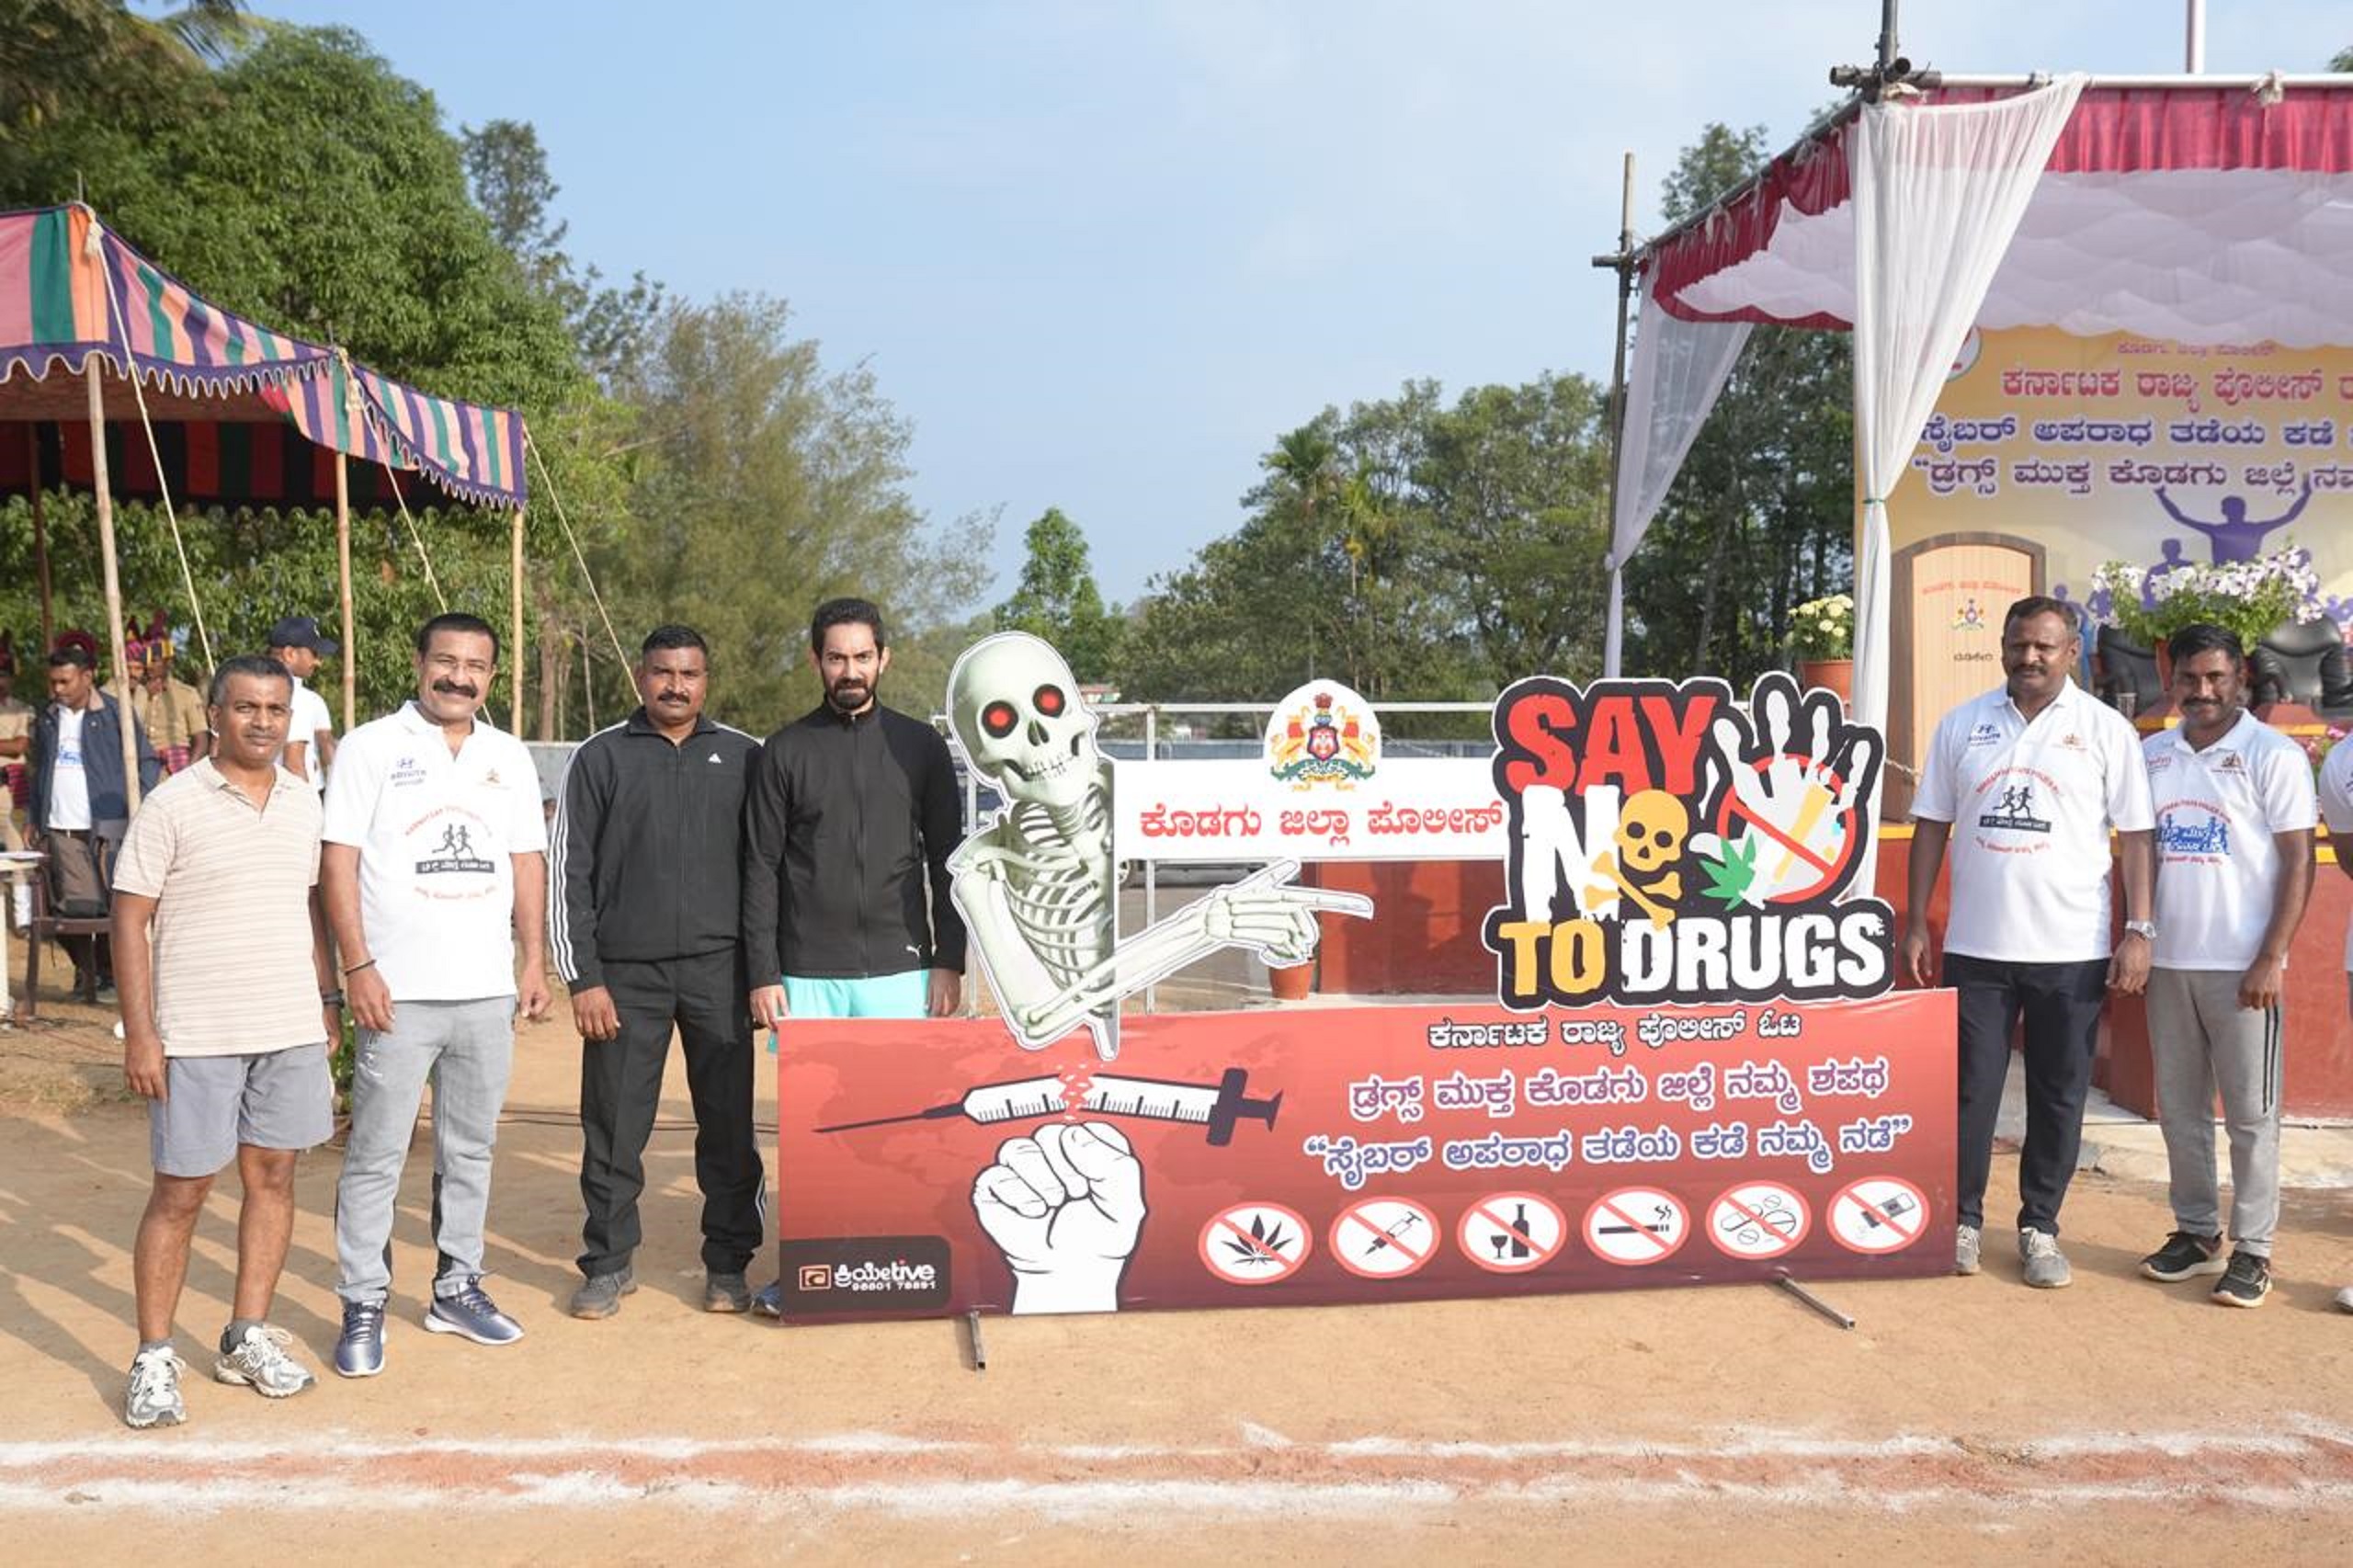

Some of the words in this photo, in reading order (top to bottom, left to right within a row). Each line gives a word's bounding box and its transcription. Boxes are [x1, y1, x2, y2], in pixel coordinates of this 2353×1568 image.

[2003, 369, 2120, 396] ಕರ್ನಾಟಕ
[2138, 369, 2199, 414] ರಾಜ್ಯ
[2214, 369, 2322, 405] ಪೊಲೀಸ್
[1922, 415, 2016, 453] ಸೈಬರ್
[2033, 420, 2152, 446] ಅಪರಾಧ
[2171, 423, 2265, 445] ತಡೆಯ
[2285, 421, 2333, 445] ಕಡೆ
[2014, 461, 2091, 494] ಮುಕ್ತ
[2110, 463, 2227, 487] ಕೊಡಗು
[2245, 462, 2296, 495] ಜಿಲ್ಲೆ
[1505, 694, 1718, 795] SAY
[1141, 801, 1261, 837] ಕೊಡಗು
[1280, 802, 1351, 846] ಜಿಲ್ಲಾ
[1369, 798, 1504, 835] ಪೊಲೀಸ್
[1498, 921, 1607, 999] TO
[1621, 915, 1888, 994] DRUGS
[1428, 1017, 1550, 1048] ಕರ್ನಾಟಕ
[1562, 1018, 1627, 1054] ರಾಜ್ಯ
[1639, 1011, 1745, 1047] ಪೊಲೀಸ್
[1757, 1011, 1801, 1037] ಓಟ
[1350, 1081, 1422, 1120] ಡ್ರಗ್ಸ್
[1438, 1075, 1514, 1113] ಮುಕ್ತ
[1529, 1072, 1645, 1103] ಕೊಡಗು
[1662, 1069, 1712, 1108] ಜಿಲ್ಲೆ
[1728, 1066, 1799, 1111] ನಮ್ಮ
[1812, 1060, 1889, 1095] ಶಪಥ
[1305, 1140, 1430, 1187] “ಸೈಬರ್
[1446, 1136, 1571, 1169] ಅಪರಾಧ
[1586, 1131, 1677, 1159] ತಡೆಯ
[1695, 1127, 1745, 1154] ಕಡೆ
[1761, 1123, 1830, 1170] ನಮ್ಮ
[1844, 1118, 1912, 1150] ನಡೆ”
